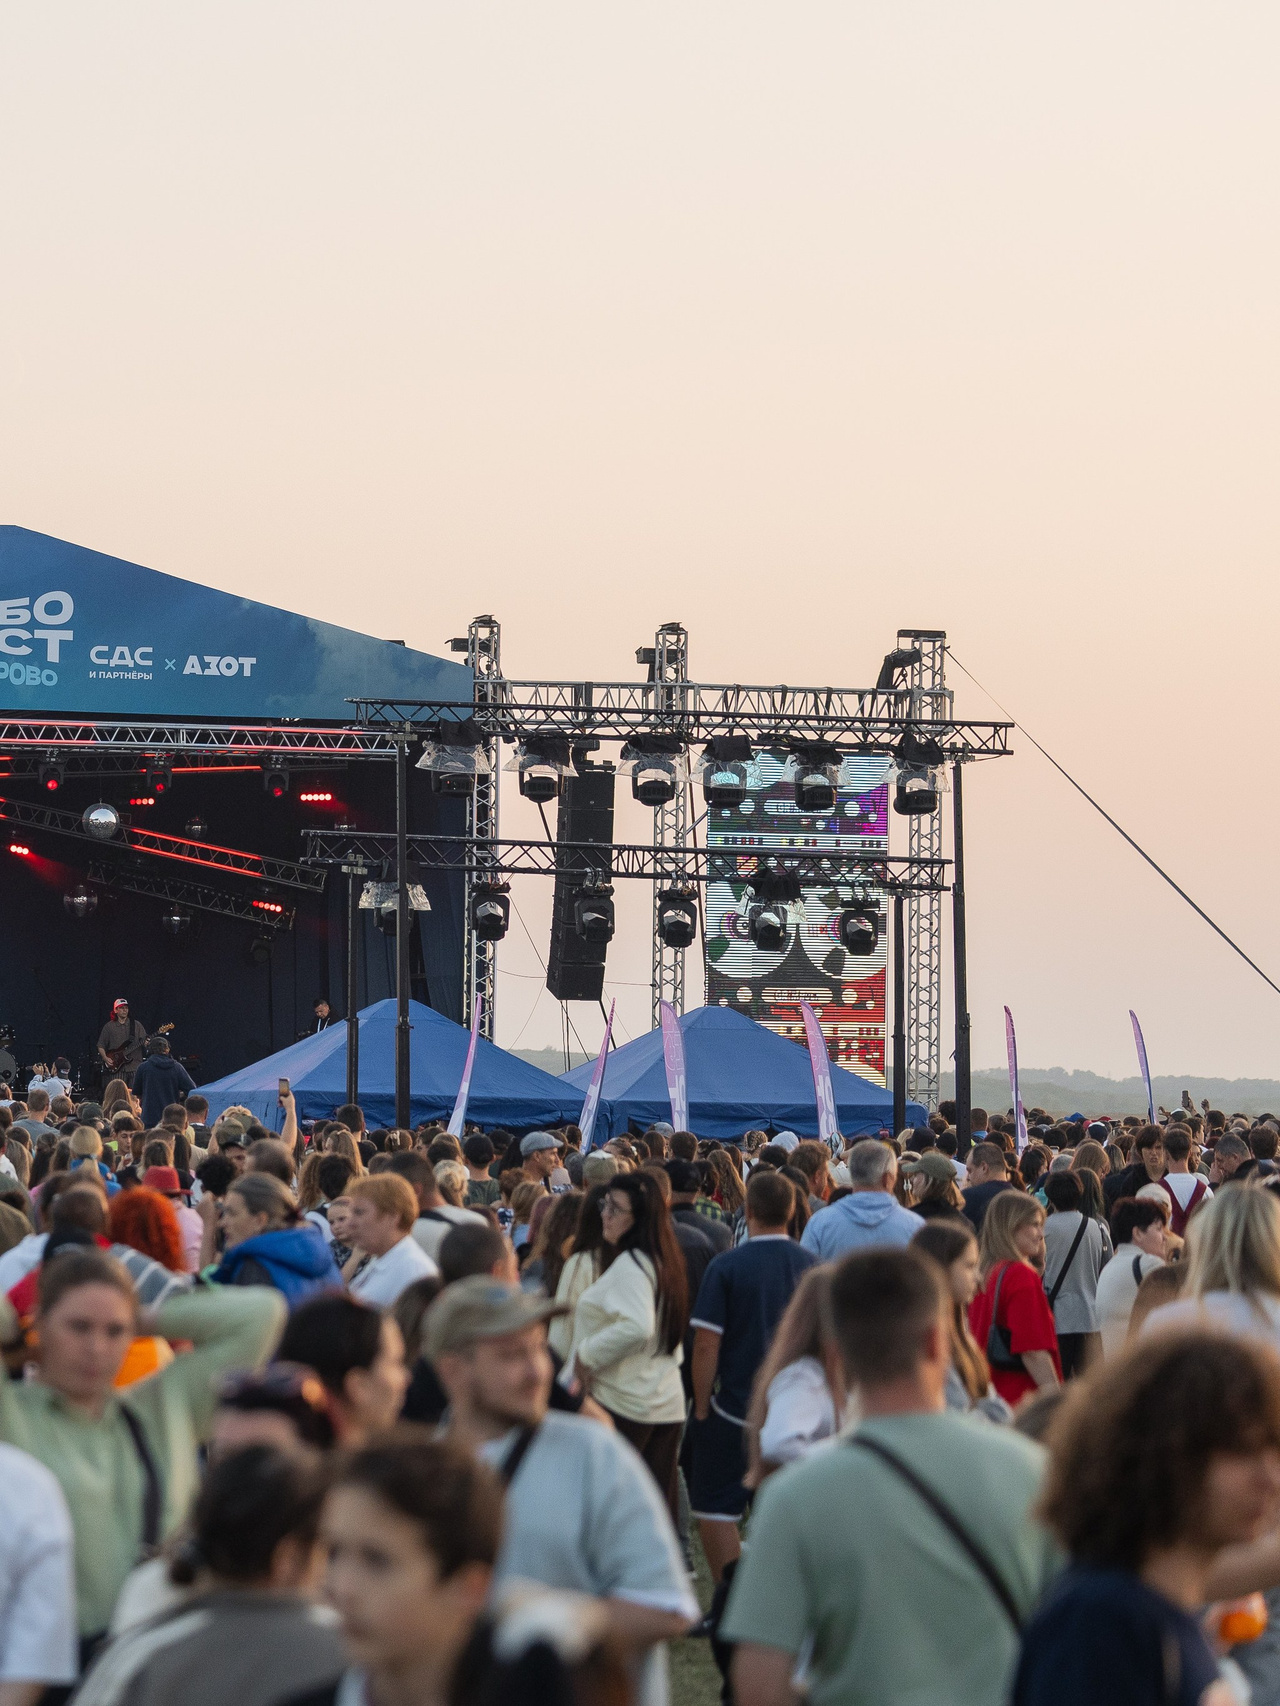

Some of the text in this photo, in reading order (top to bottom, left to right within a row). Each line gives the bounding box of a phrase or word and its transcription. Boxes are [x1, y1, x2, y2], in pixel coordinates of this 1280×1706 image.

[89, 645, 153, 667] СДС
[182, 655, 257, 677] АЗОТ
[89, 671, 153, 680] И ПАРТНЁРЫ
